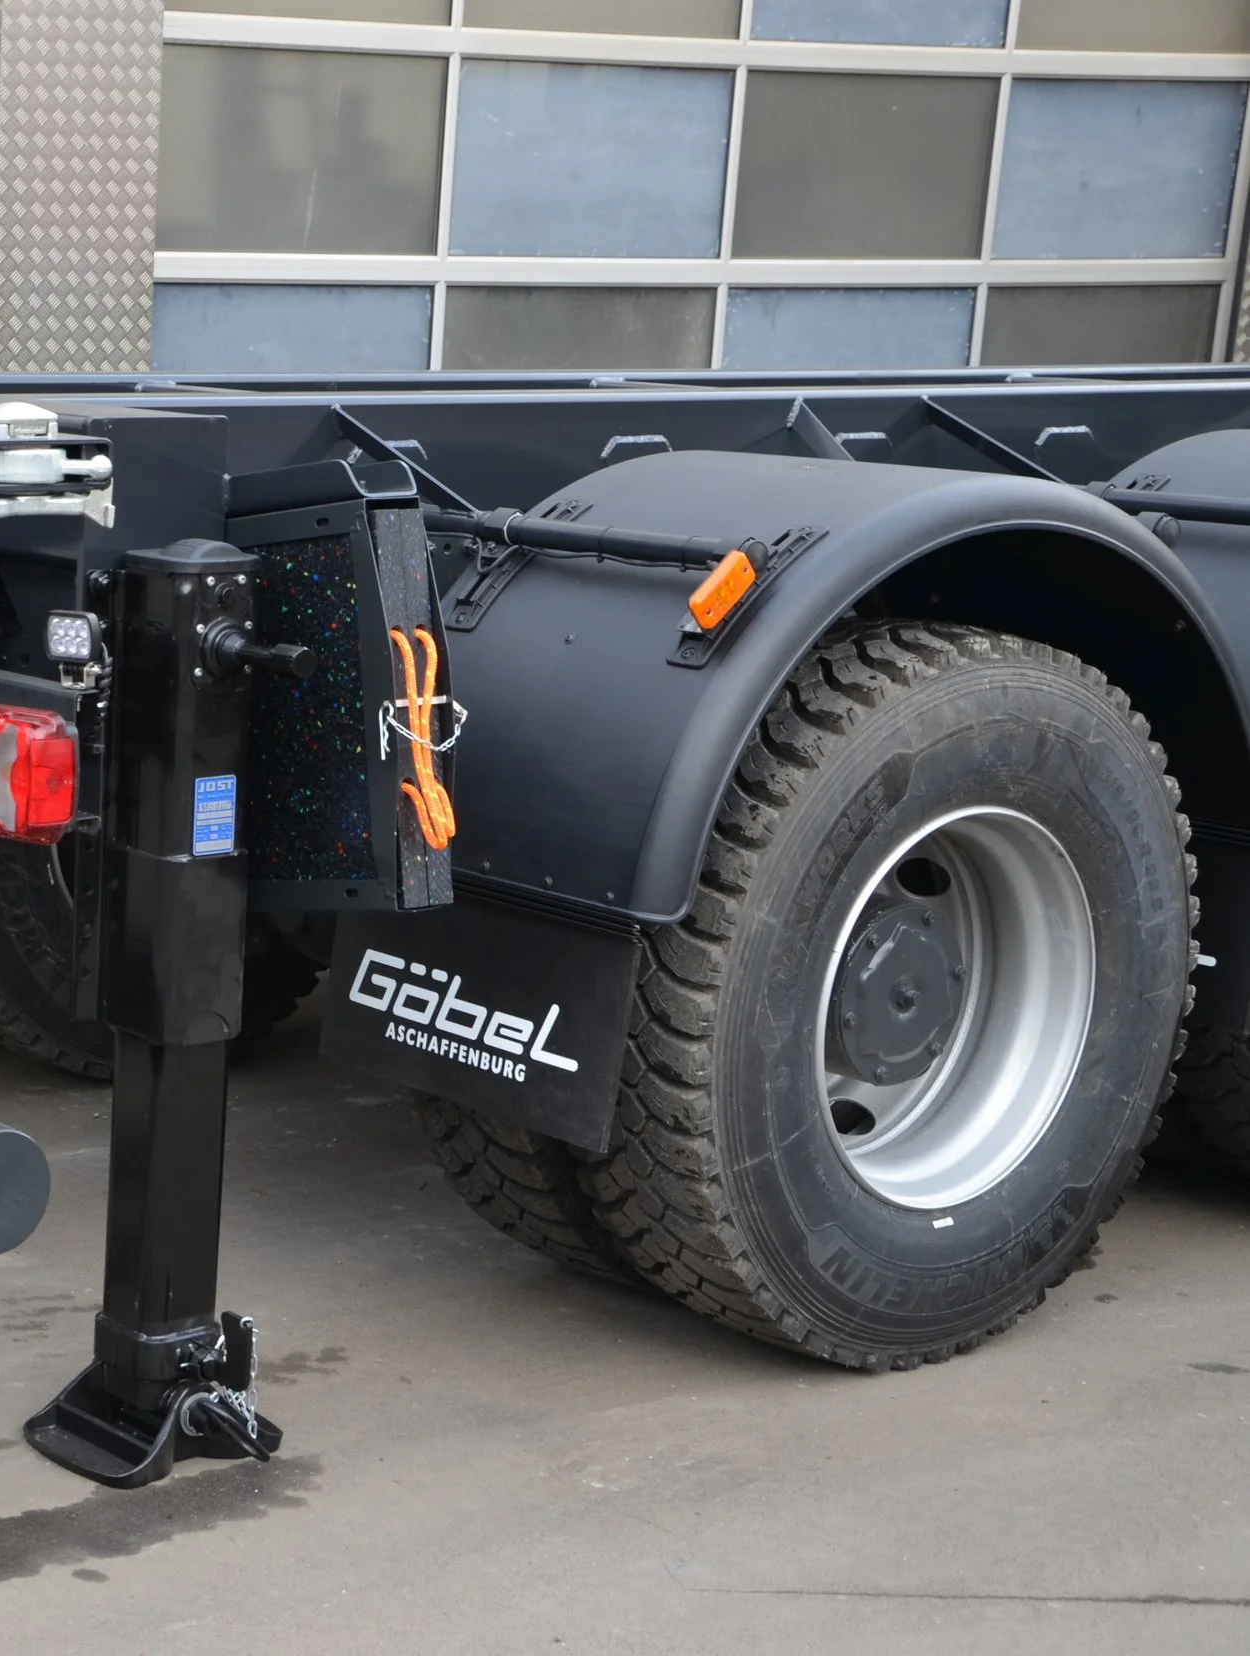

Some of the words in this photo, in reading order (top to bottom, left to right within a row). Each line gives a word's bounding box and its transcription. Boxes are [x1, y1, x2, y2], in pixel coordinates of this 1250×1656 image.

[198, 780, 234, 793] JOST
[385, 1022, 527, 1082] ASCHAFFENBURG
[820, 1239, 1026, 1313] MICHELIN
